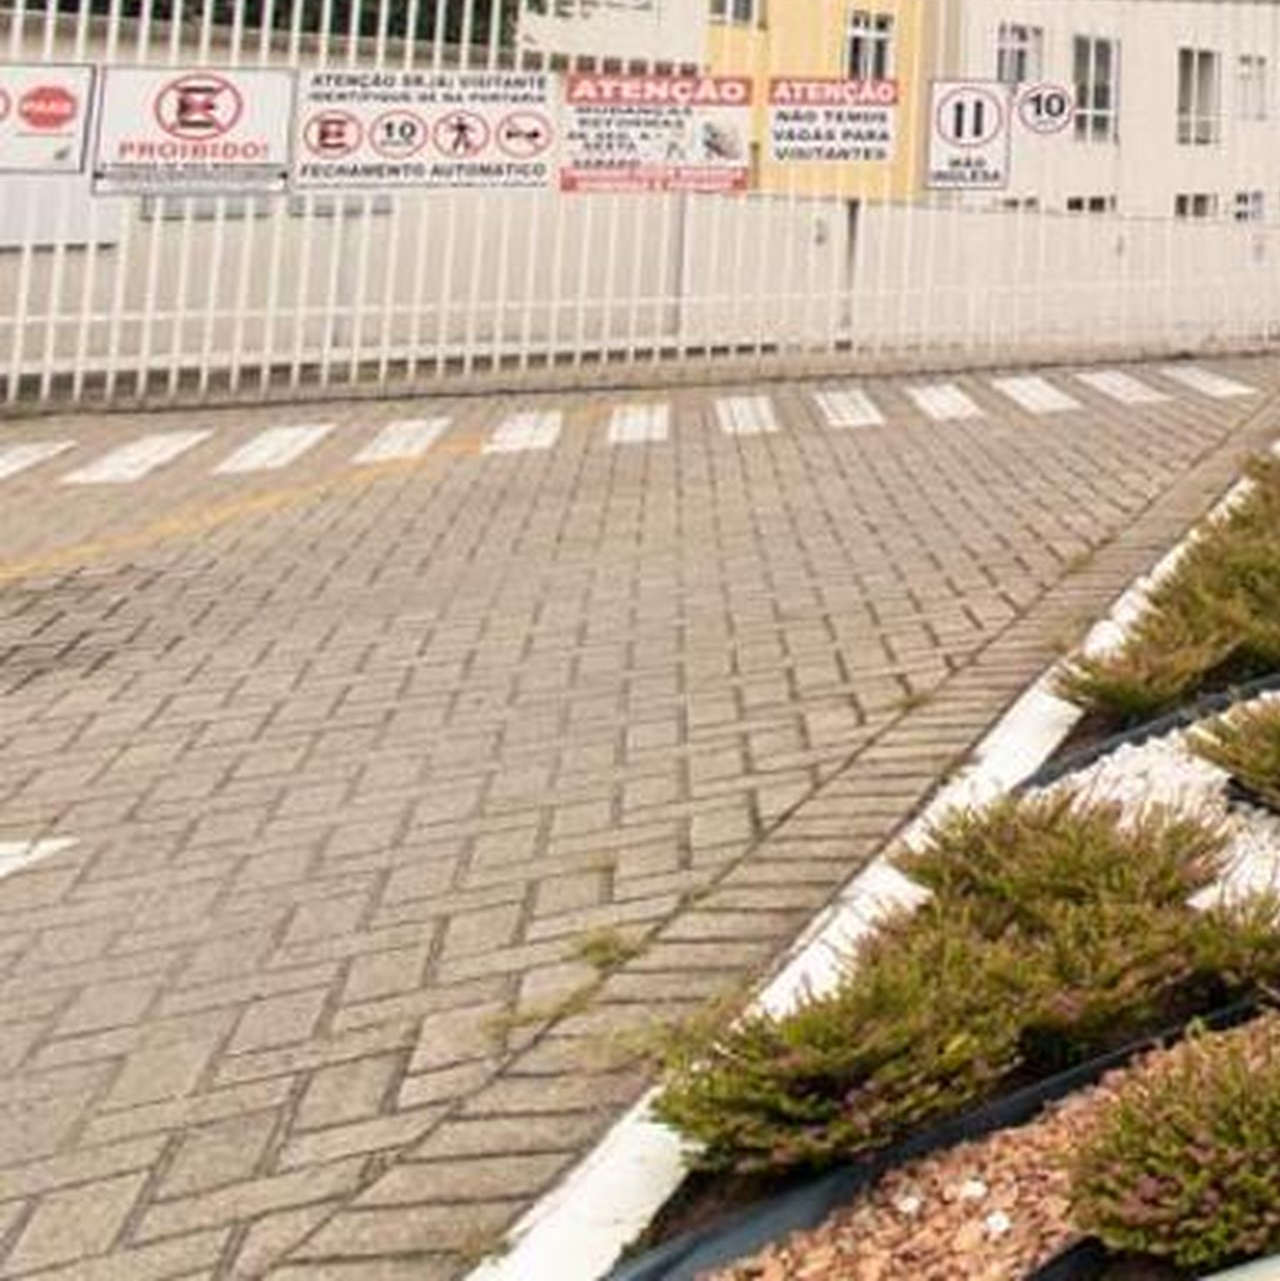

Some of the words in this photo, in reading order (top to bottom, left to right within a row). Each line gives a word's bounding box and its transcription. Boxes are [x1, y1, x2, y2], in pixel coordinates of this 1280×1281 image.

[572, 77, 747, 103] ATENÇÃO
[774, 79, 895, 103] ATENÇÃO
[1031, 93, 1065, 117] 10
[384, 122, 416, 138] 10
[773, 128, 835, 141] VAGAS
[841, 128, 890, 141] PARA
